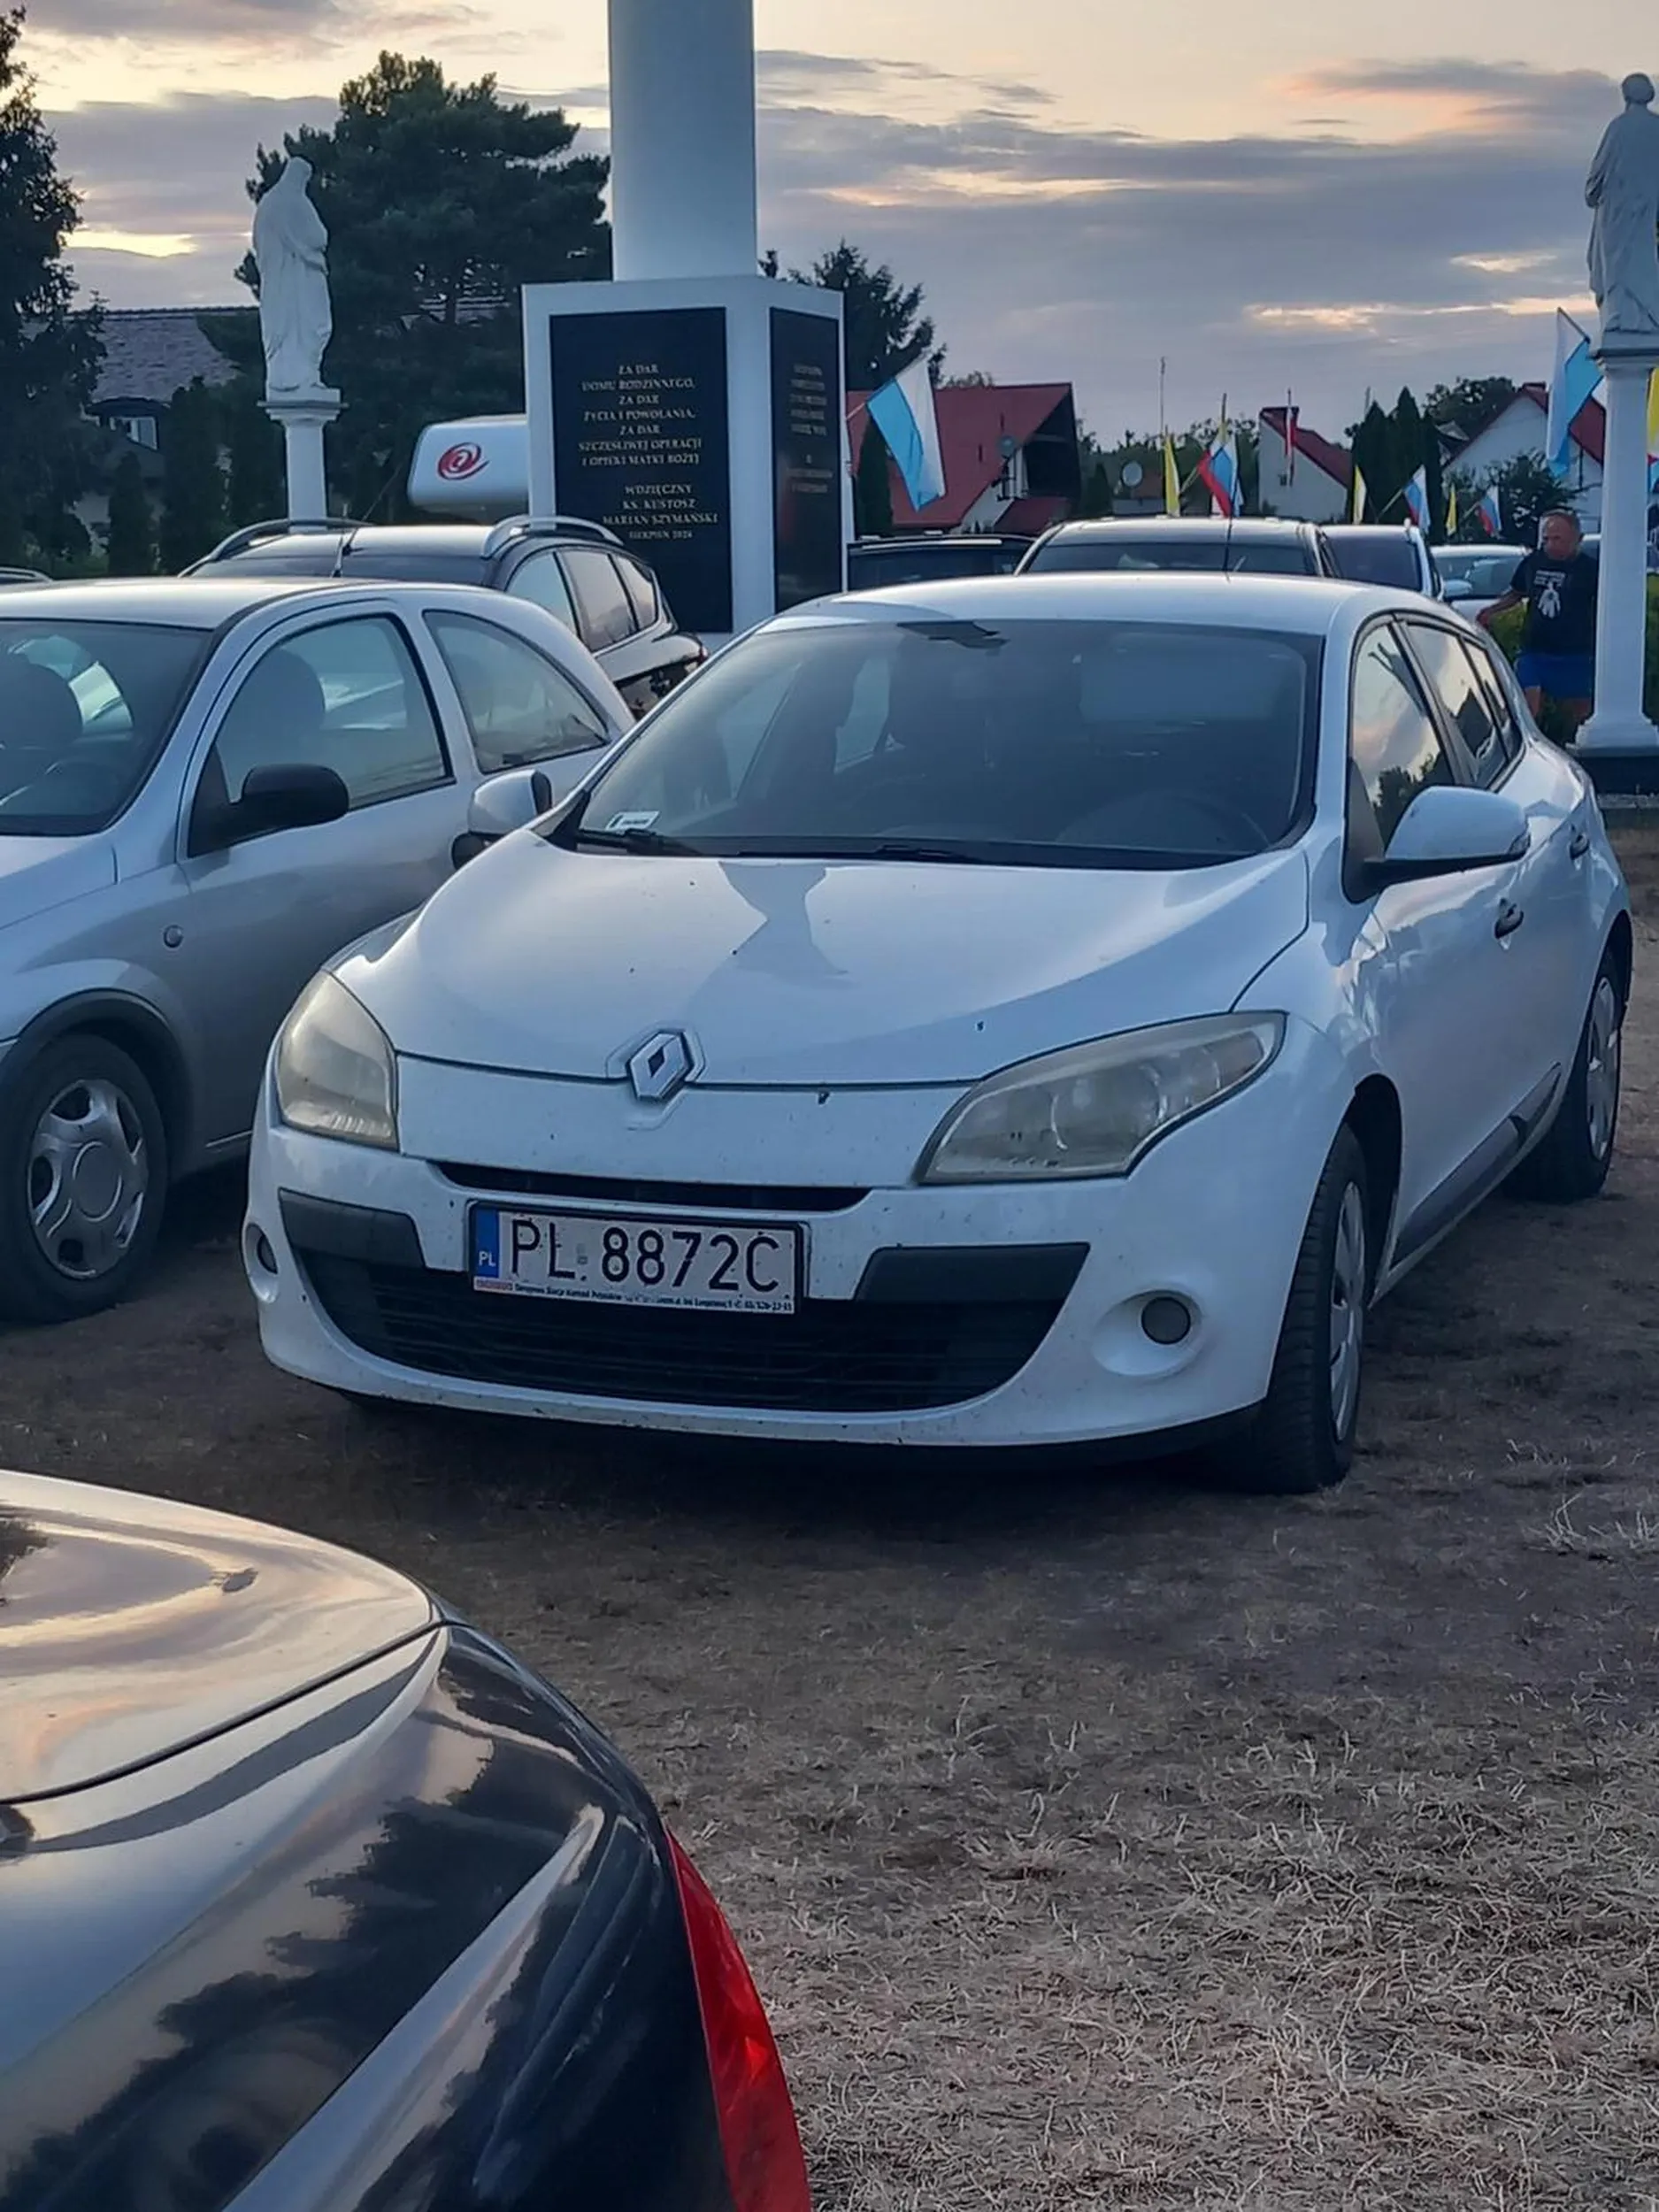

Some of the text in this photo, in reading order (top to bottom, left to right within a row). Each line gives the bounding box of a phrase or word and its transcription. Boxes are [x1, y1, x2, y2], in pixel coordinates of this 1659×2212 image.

[618, 363, 659, 376] ZA DAR
[581, 380, 617, 392] DOMU
[618, 394, 660, 406] ZA DAR
[619, 424, 661, 436] ZA DAR
[643, 498, 696, 510] KUSTOSZ
[603, 515, 649, 526] MARIAN
[478, 1251, 496, 1267] PL
[601, 1226, 780, 1293] 8872C
